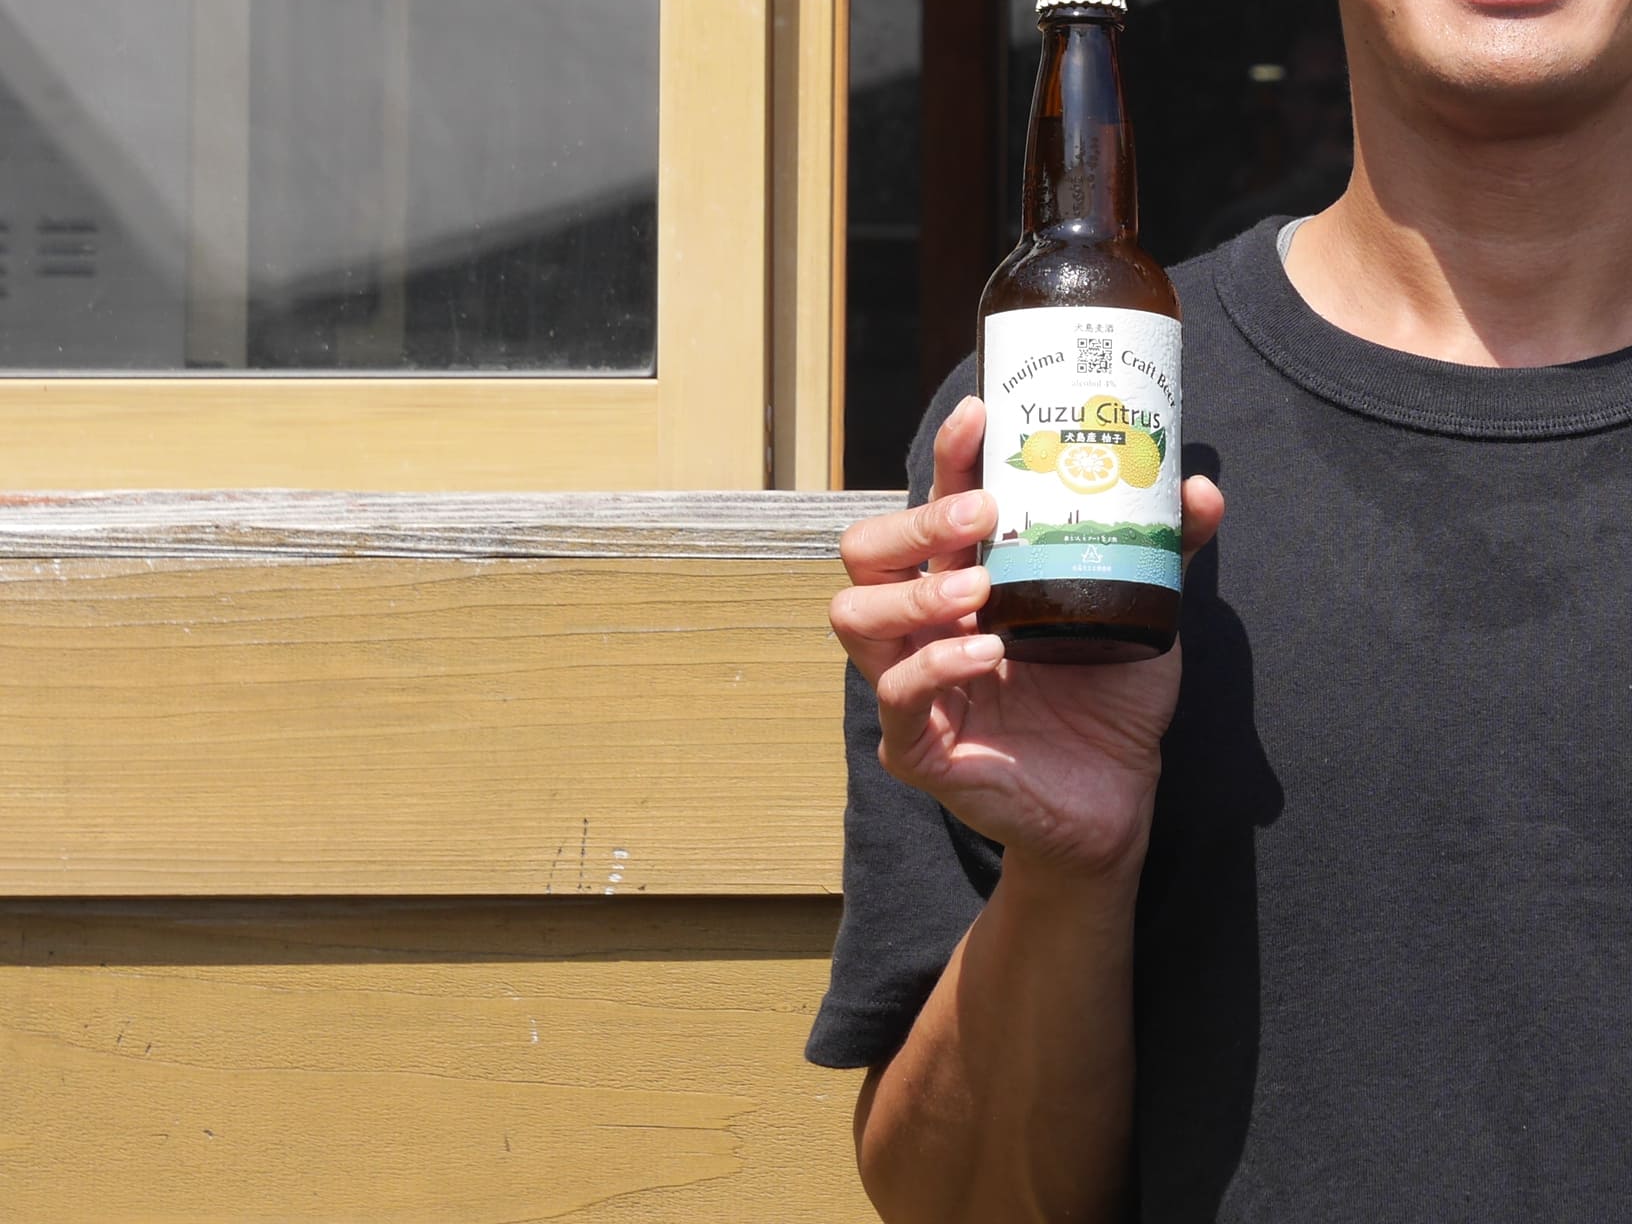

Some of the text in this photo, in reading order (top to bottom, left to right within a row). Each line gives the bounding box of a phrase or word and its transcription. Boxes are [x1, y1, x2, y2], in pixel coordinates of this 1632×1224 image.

[1002, 350, 1176, 408] Inujima Craft Beer
[1021, 403, 1161, 429] Yuzu Citrus
